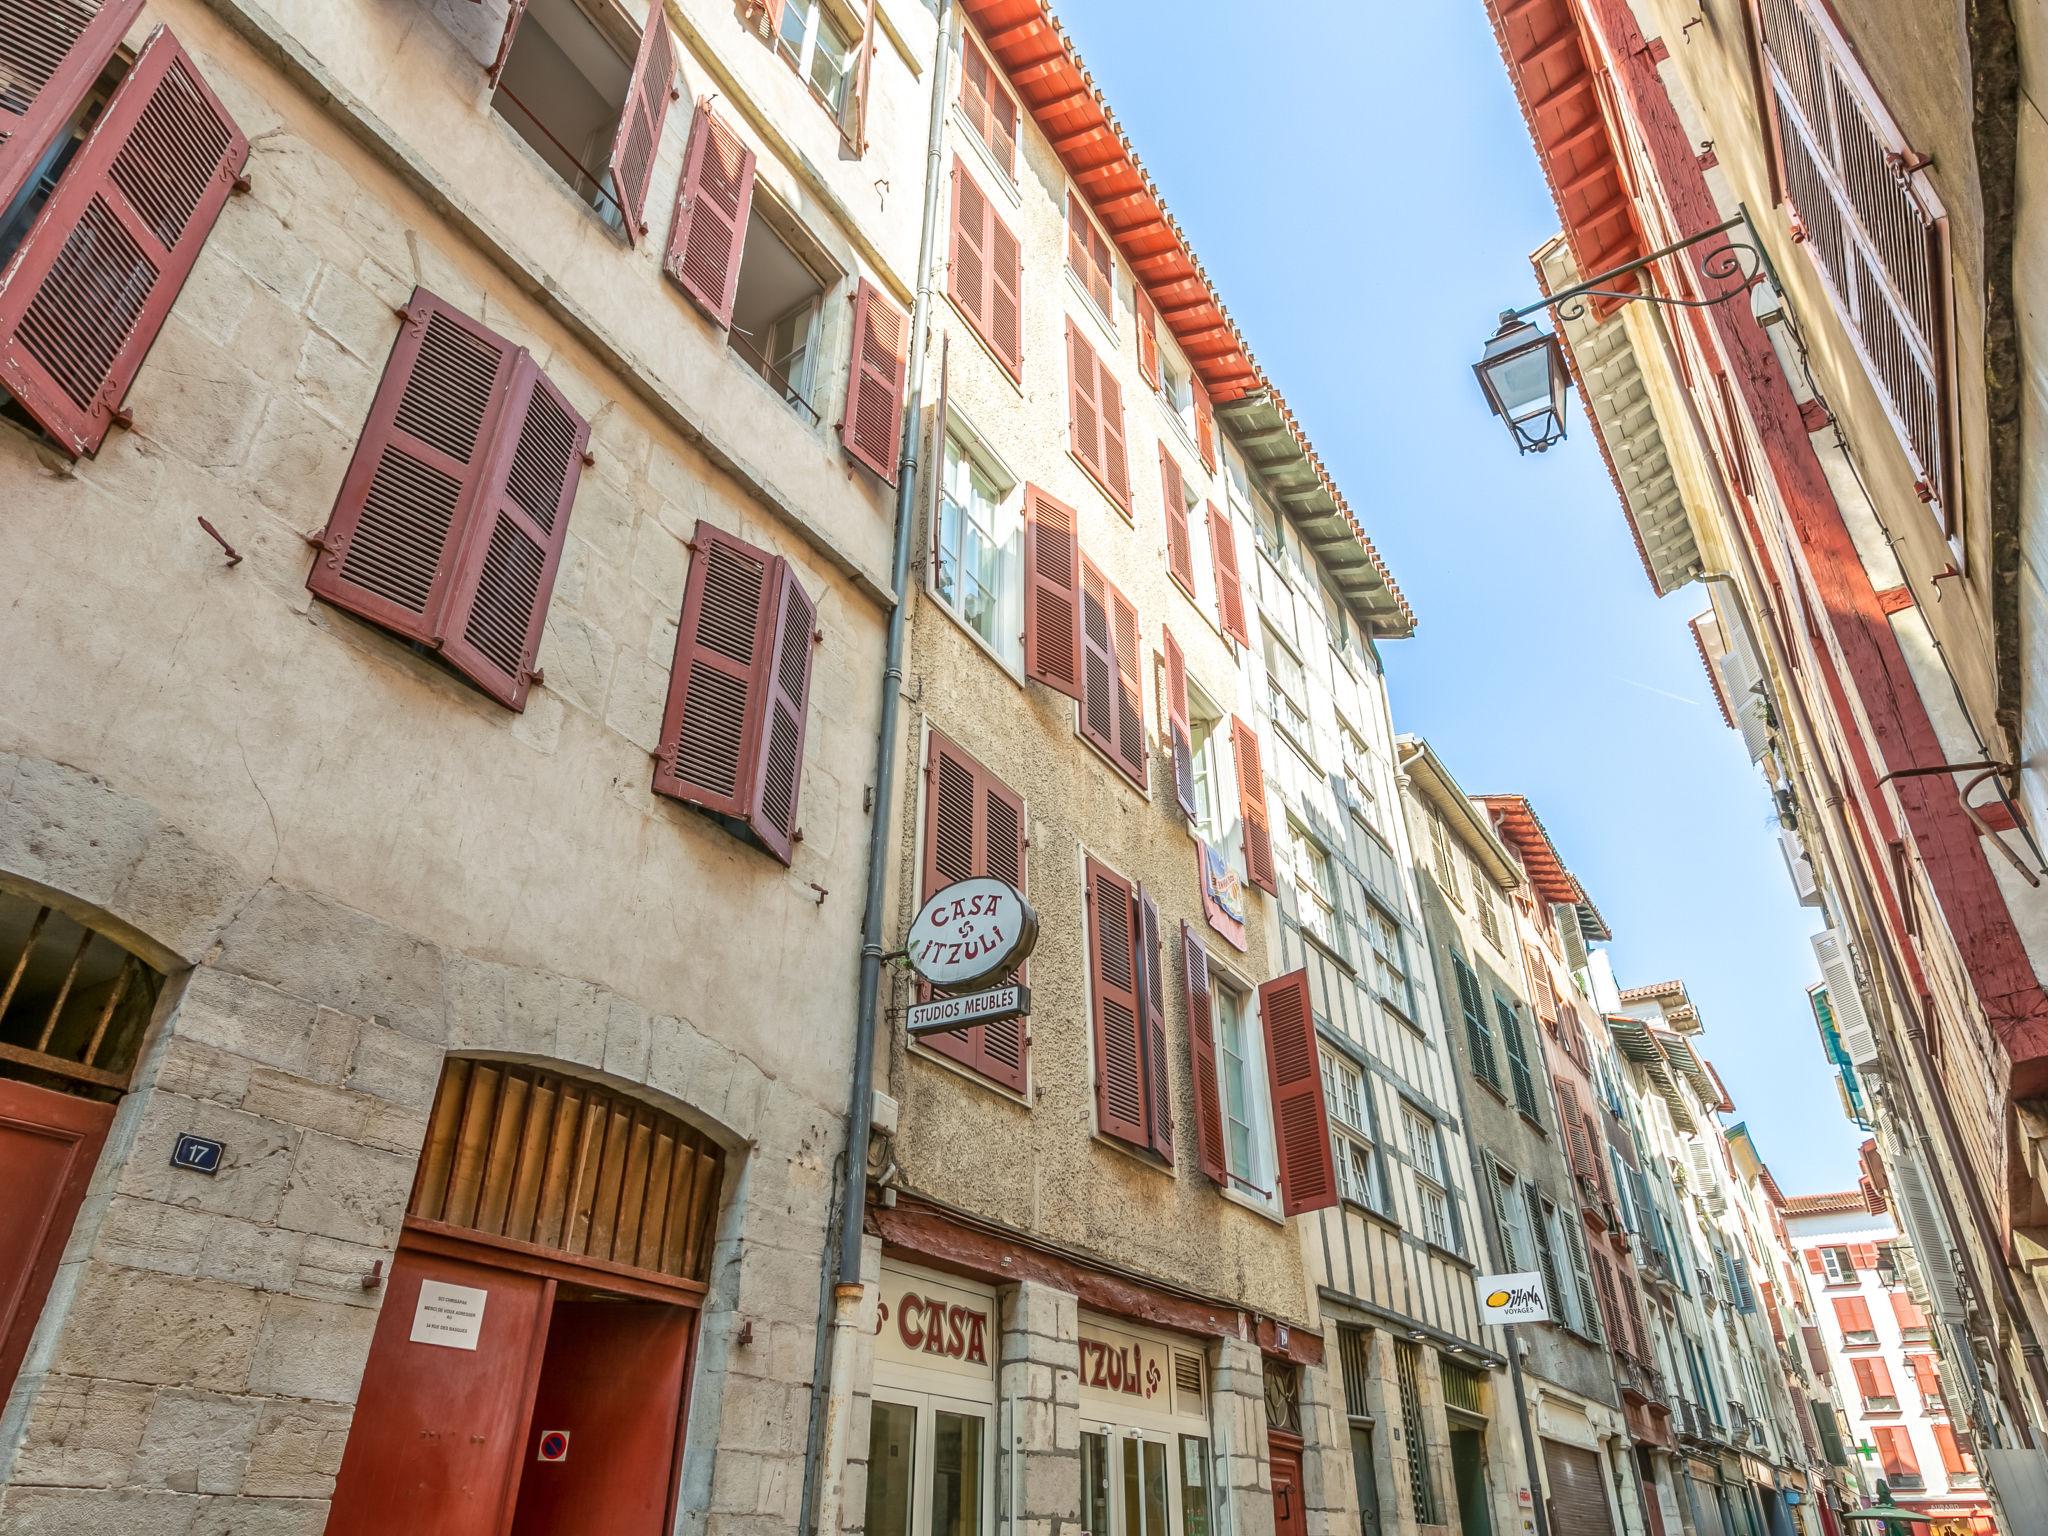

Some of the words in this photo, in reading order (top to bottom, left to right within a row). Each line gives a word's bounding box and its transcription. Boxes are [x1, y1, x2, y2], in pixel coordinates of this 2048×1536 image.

[930, 894, 1003, 927] CASA
[913, 1001, 960, 1024] STUDIOS
[964, 988, 1014, 1015] MEUBLÉS
[189, 1144, 210, 1163] 17
[1504, 1307, 1534, 1315] VOYAGES
[897, 1291, 989, 1367] CASA
